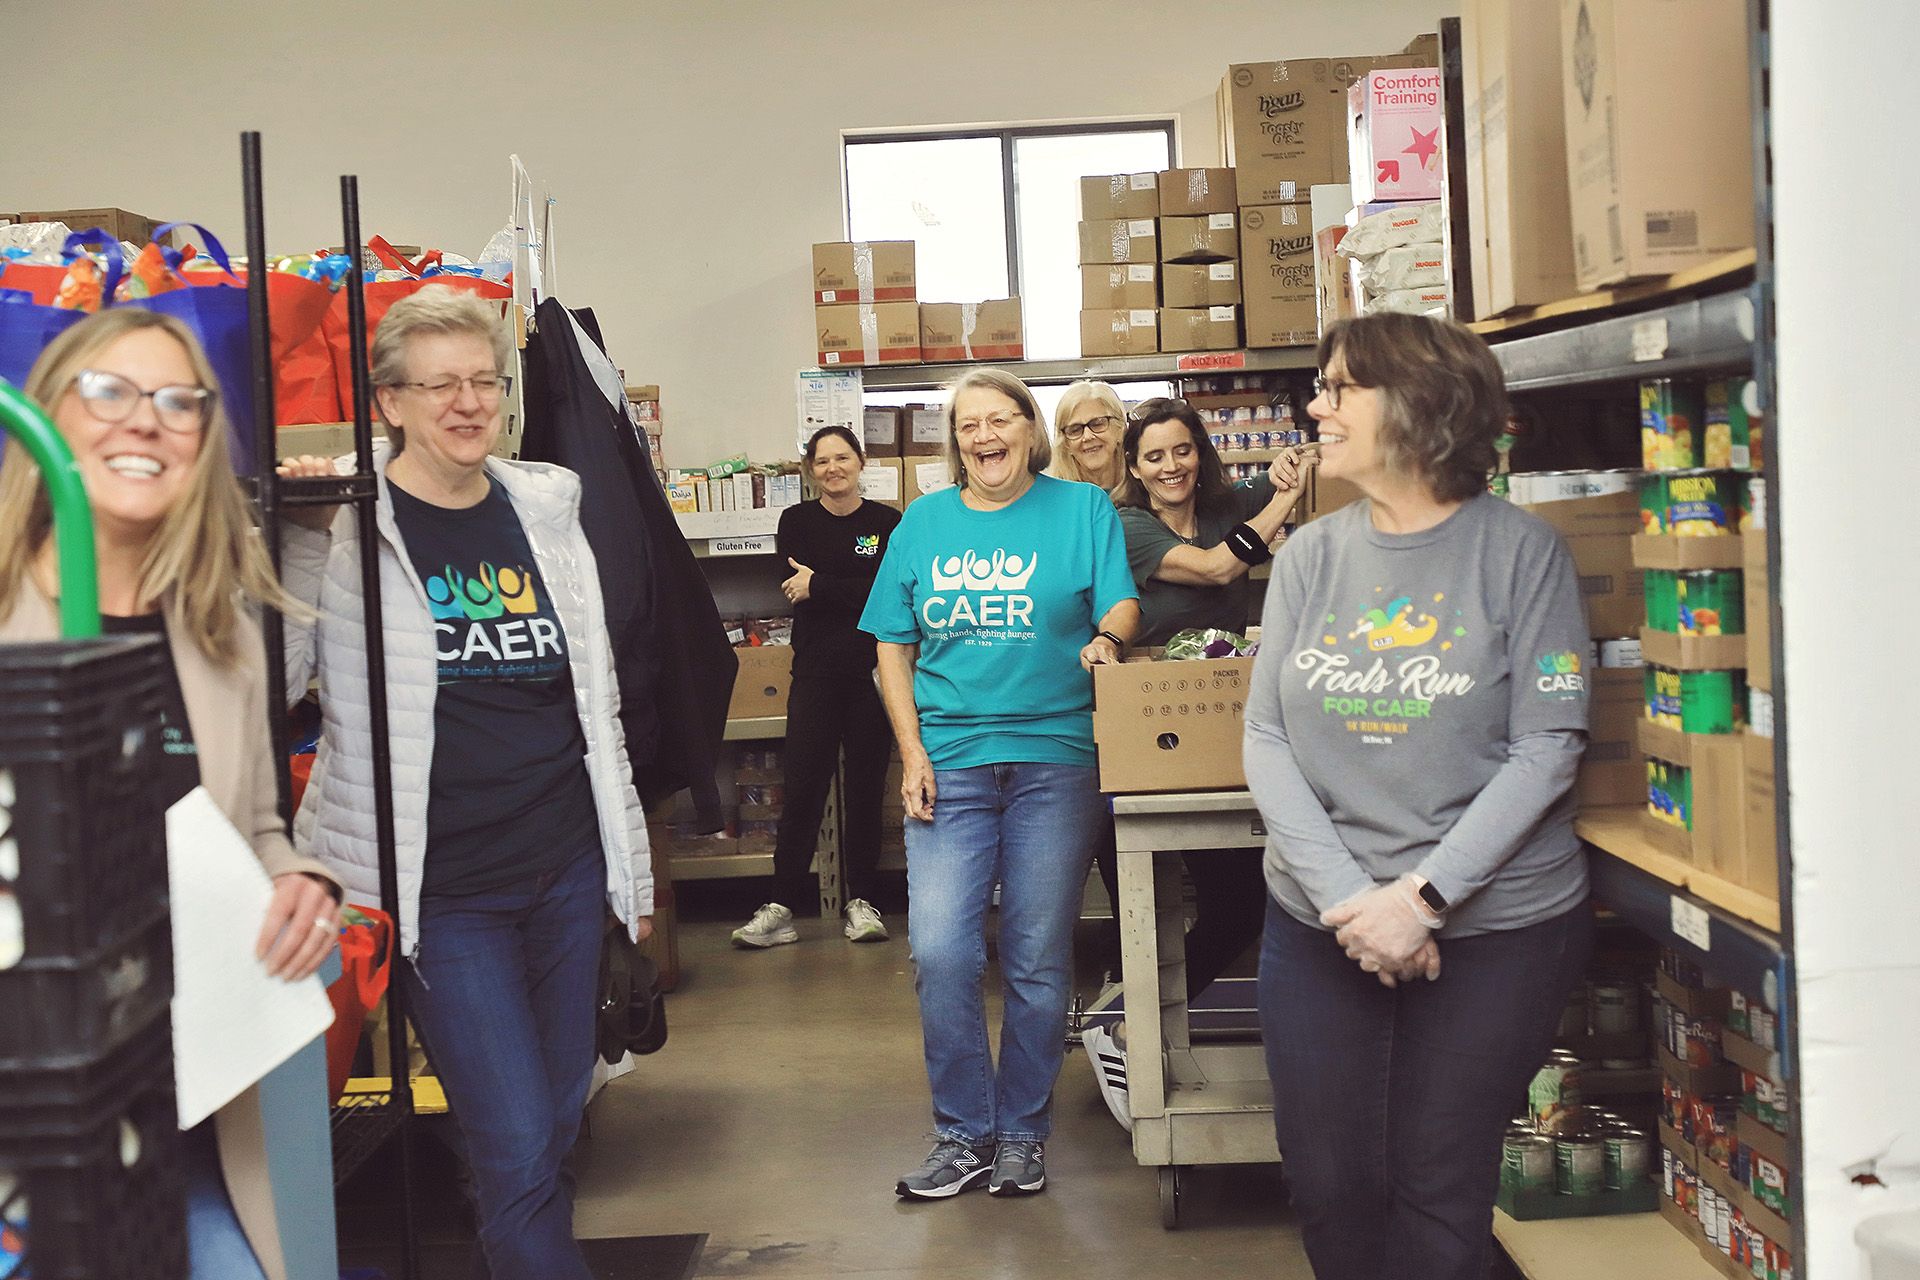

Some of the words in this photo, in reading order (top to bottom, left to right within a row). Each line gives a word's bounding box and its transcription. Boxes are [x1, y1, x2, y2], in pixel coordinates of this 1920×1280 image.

[1374, 74, 1440, 90] Comfort
[1374, 90, 1437, 105] Training
[1260, 121, 1305, 136] Toasty
[1391, 218, 1418, 228] HUGGIES
[1191, 357, 1211, 366] KIDZ
[1213, 356, 1233, 365] KITZ
[716, 542, 743, 551] Gluten
[744, 542, 762, 550] Free
[922, 594, 1034, 629] CAER
[435, 617, 562, 661] CAER
[976, 628, 1007, 640] fighting
[1213, 669, 1240, 677] PACKER
[1295, 648, 1394, 693] Fools
[1398, 655, 1475, 703] Run
[1536, 674, 1585, 692] CAER
[1323, 696, 1368, 716] FOR
[1372, 698, 1431, 718] CAER
